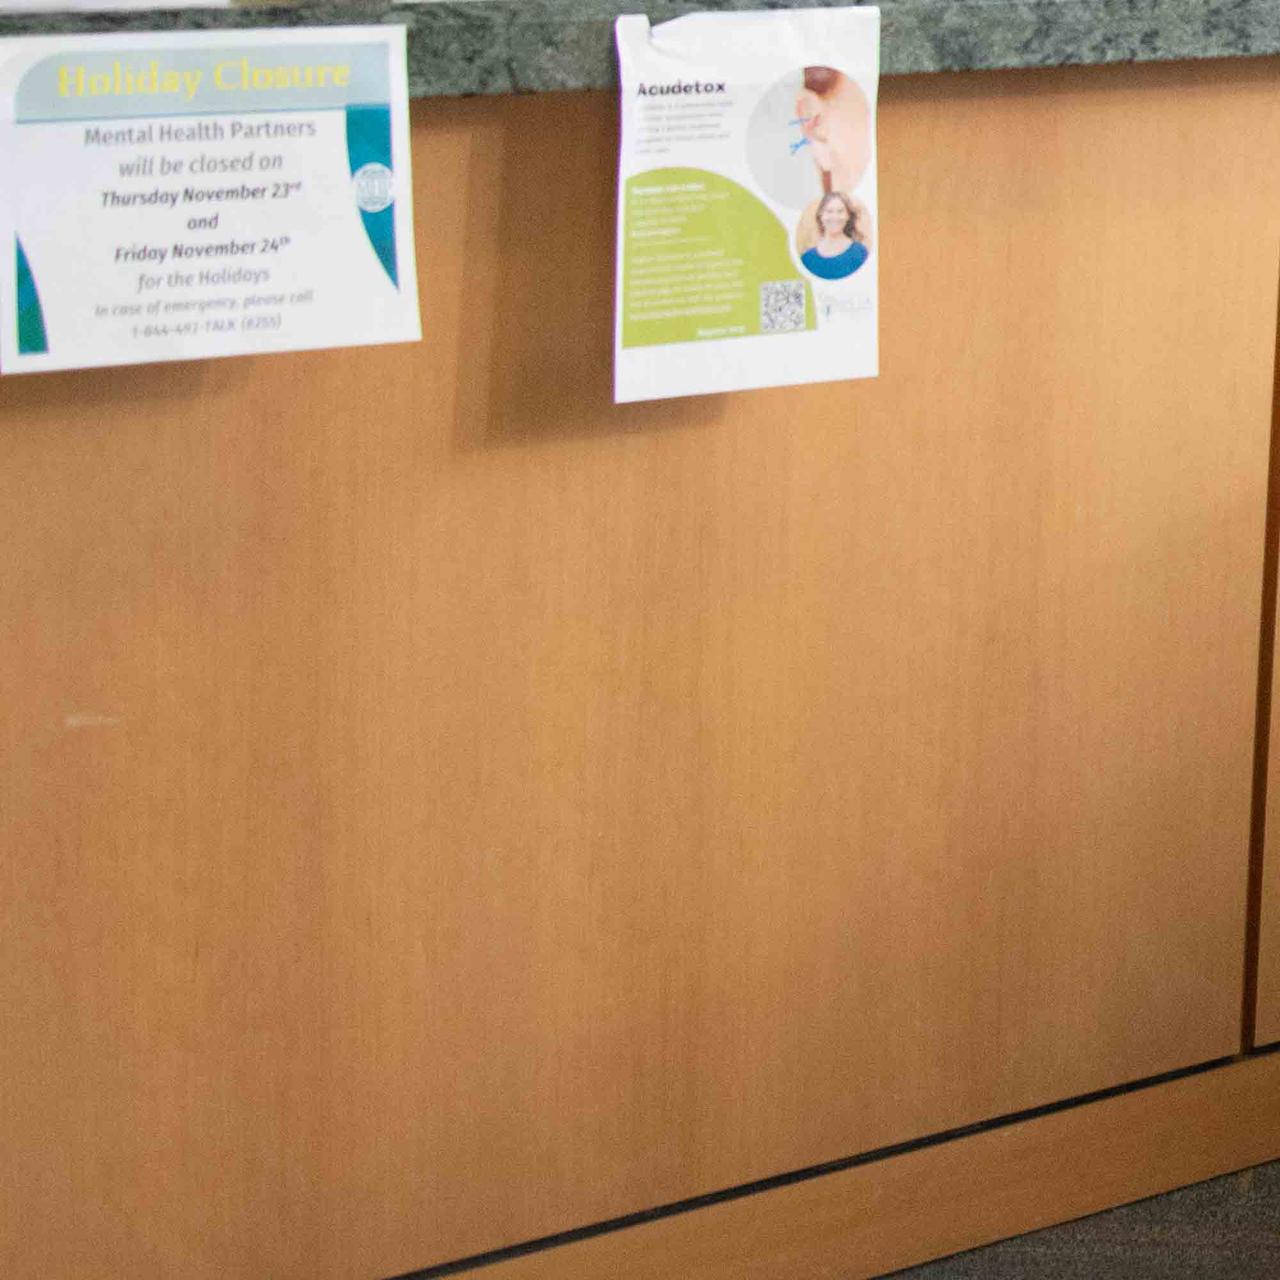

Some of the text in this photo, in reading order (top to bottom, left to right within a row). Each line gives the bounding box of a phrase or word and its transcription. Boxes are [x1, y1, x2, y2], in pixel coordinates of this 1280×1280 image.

[57, 56, 350, 101] Holiday Closure
[637, 78, 727, 97] Acudetox
[84, 119, 316, 146] Mental Health Partners
[118, 152, 283, 178] will be closed on
[102, 189, 178, 208] Thursday
[183, 185, 267, 203] November
[187, 213, 219, 230] and
[114, 246, 168, 264] Friday
[171, 240, 256, 259] November
[137, 266, 271, 294] for the Holidays
